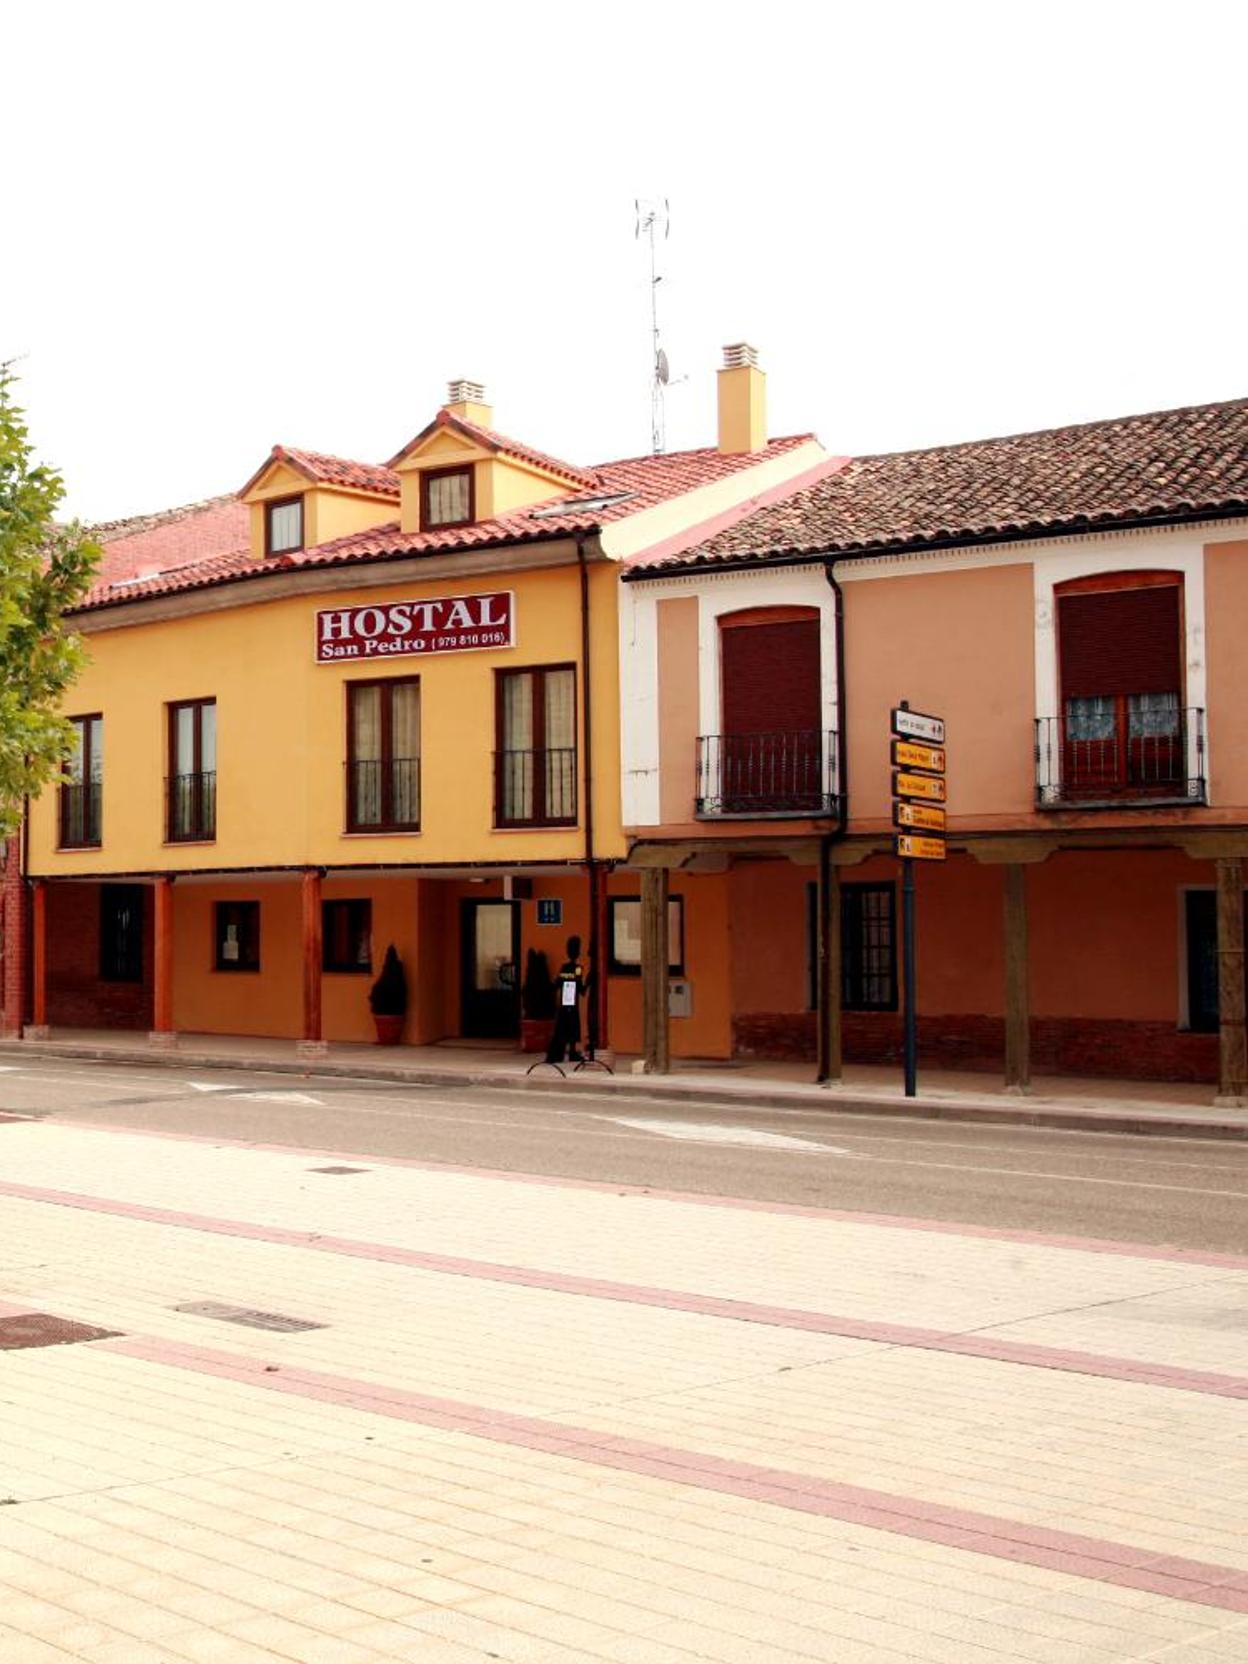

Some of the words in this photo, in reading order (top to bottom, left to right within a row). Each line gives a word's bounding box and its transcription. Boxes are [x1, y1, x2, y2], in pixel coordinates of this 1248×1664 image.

[320, 597, 507, 641] HOSTAL
[321, 642, 359, 659] San
[364, 636, 426, 655] Pedro
